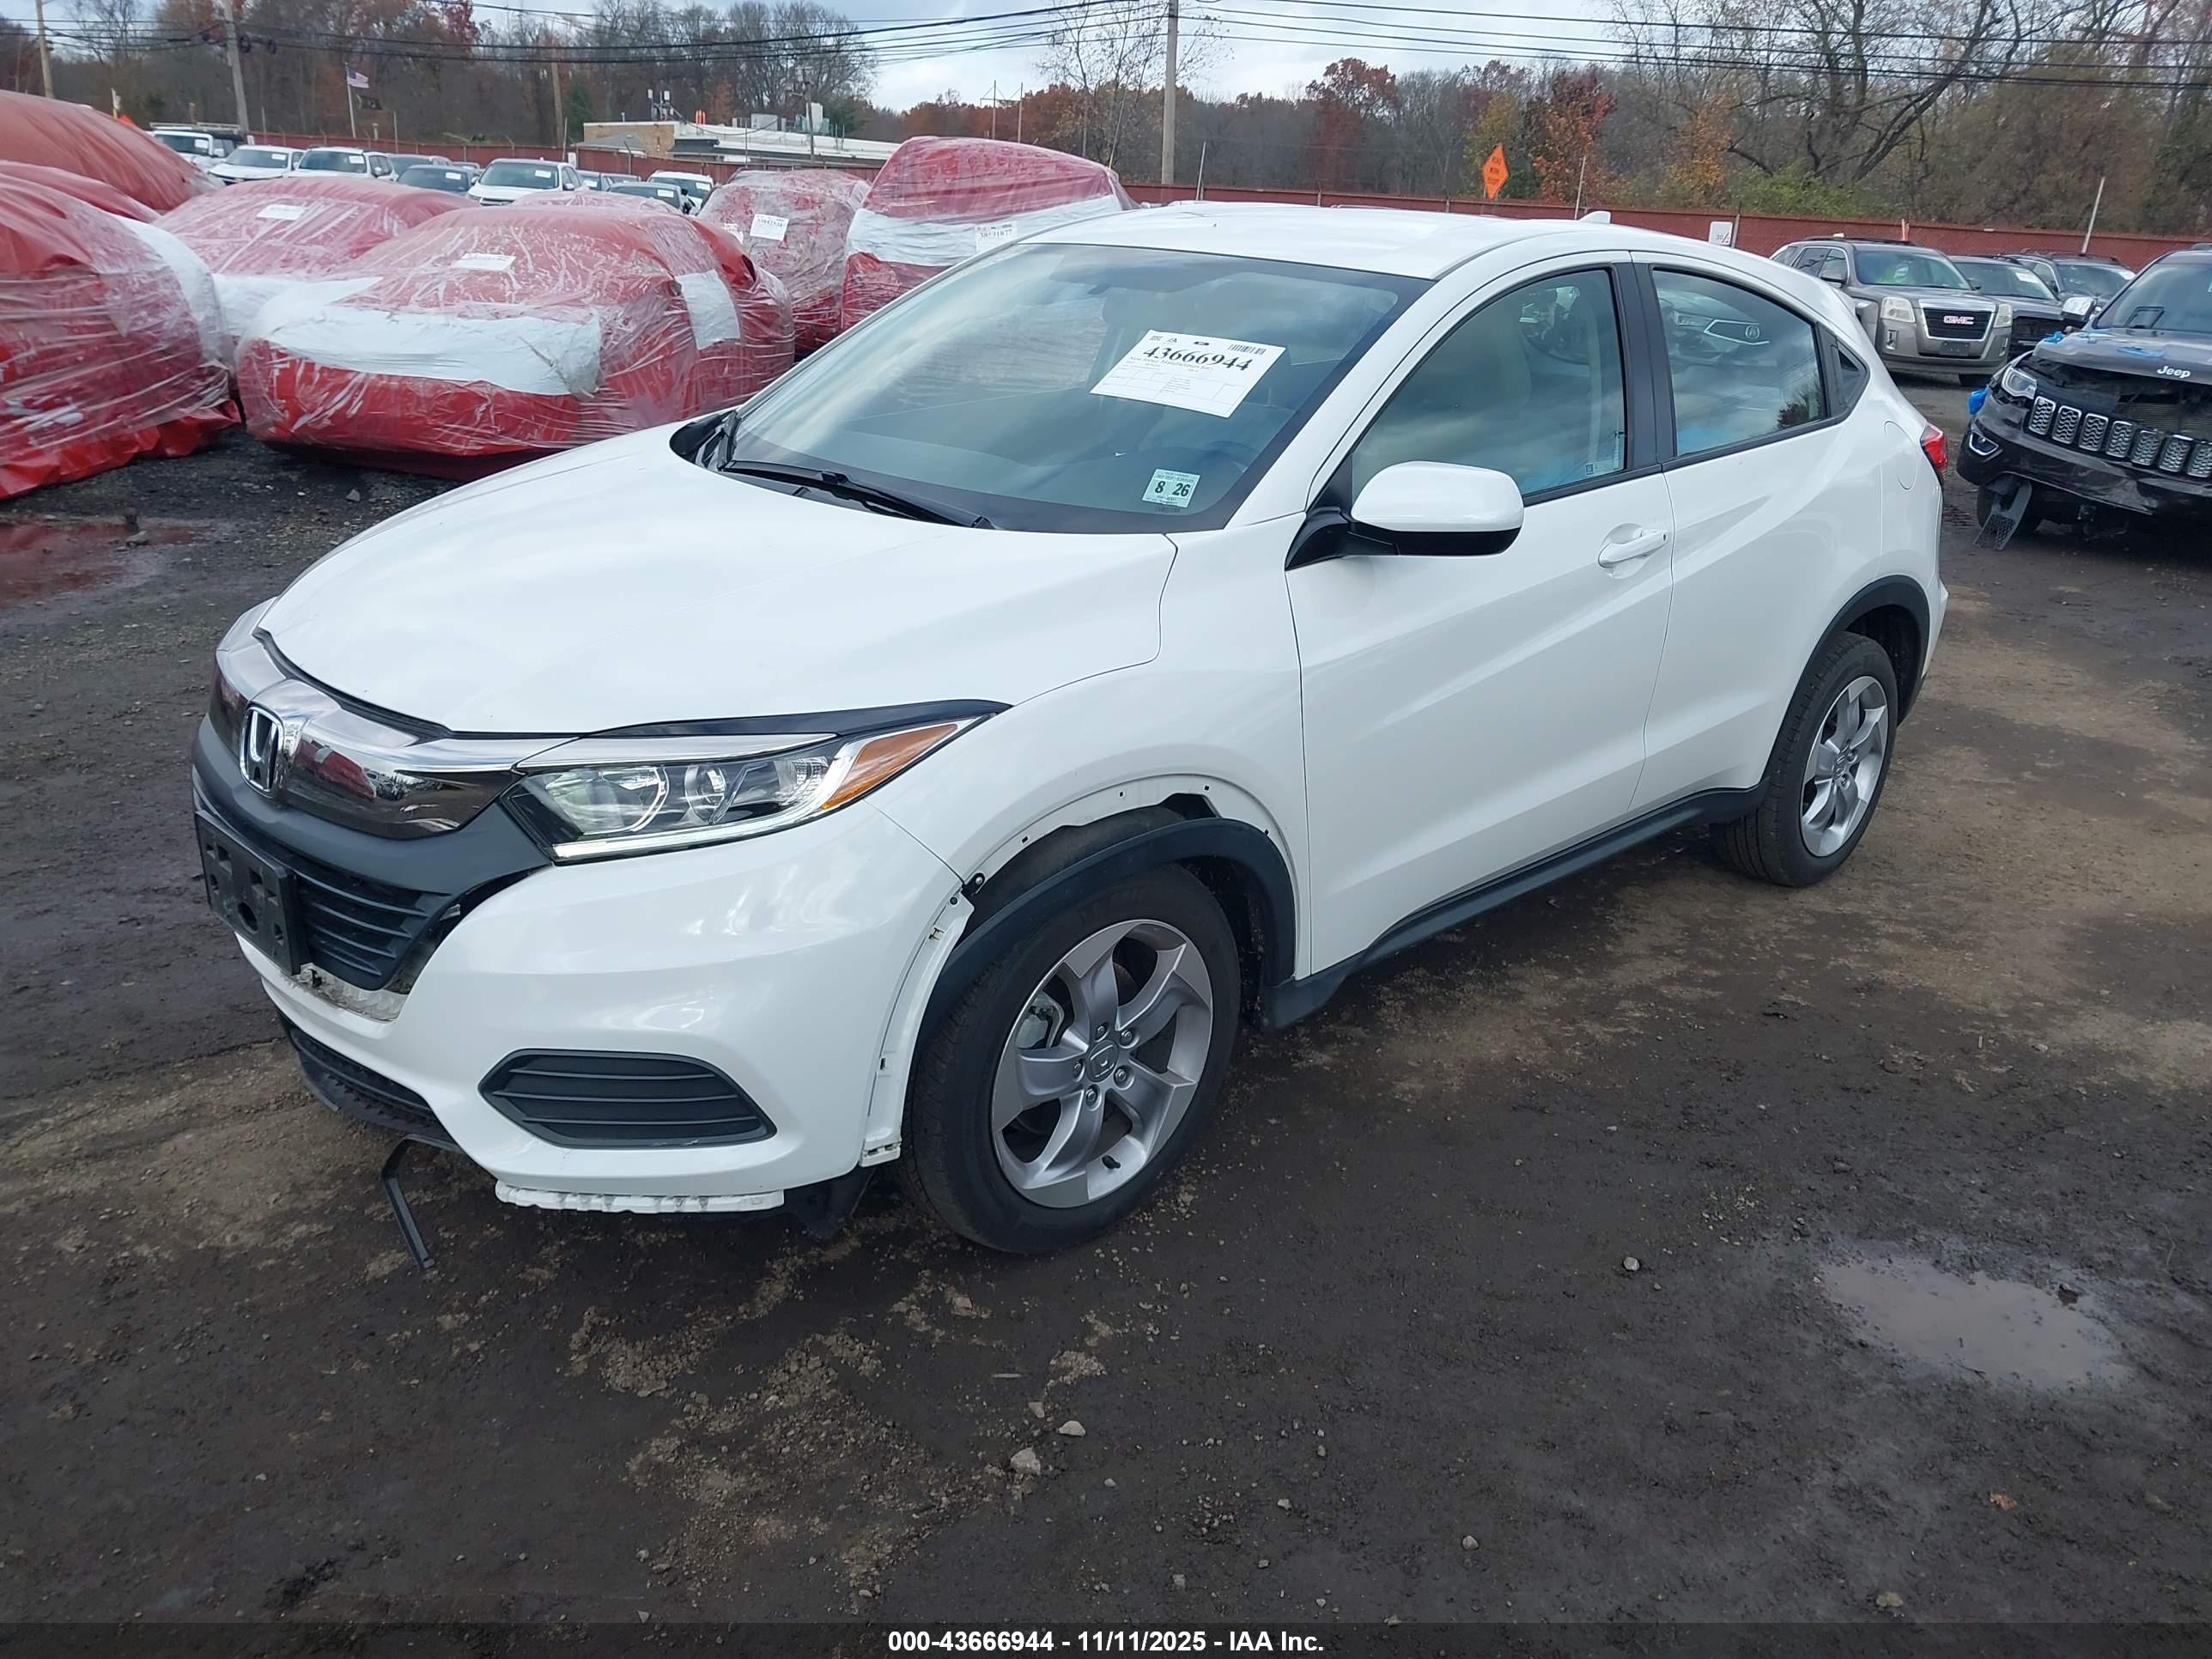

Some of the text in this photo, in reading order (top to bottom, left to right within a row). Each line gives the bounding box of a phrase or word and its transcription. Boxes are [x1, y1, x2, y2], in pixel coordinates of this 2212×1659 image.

[1943, 315, 1974, 325] GMC
[1143, 346, 1253, 371] 43666944
[2156, 365, 2191, 379] Jeep
[1155, 481, 1191, 497] 8 26
